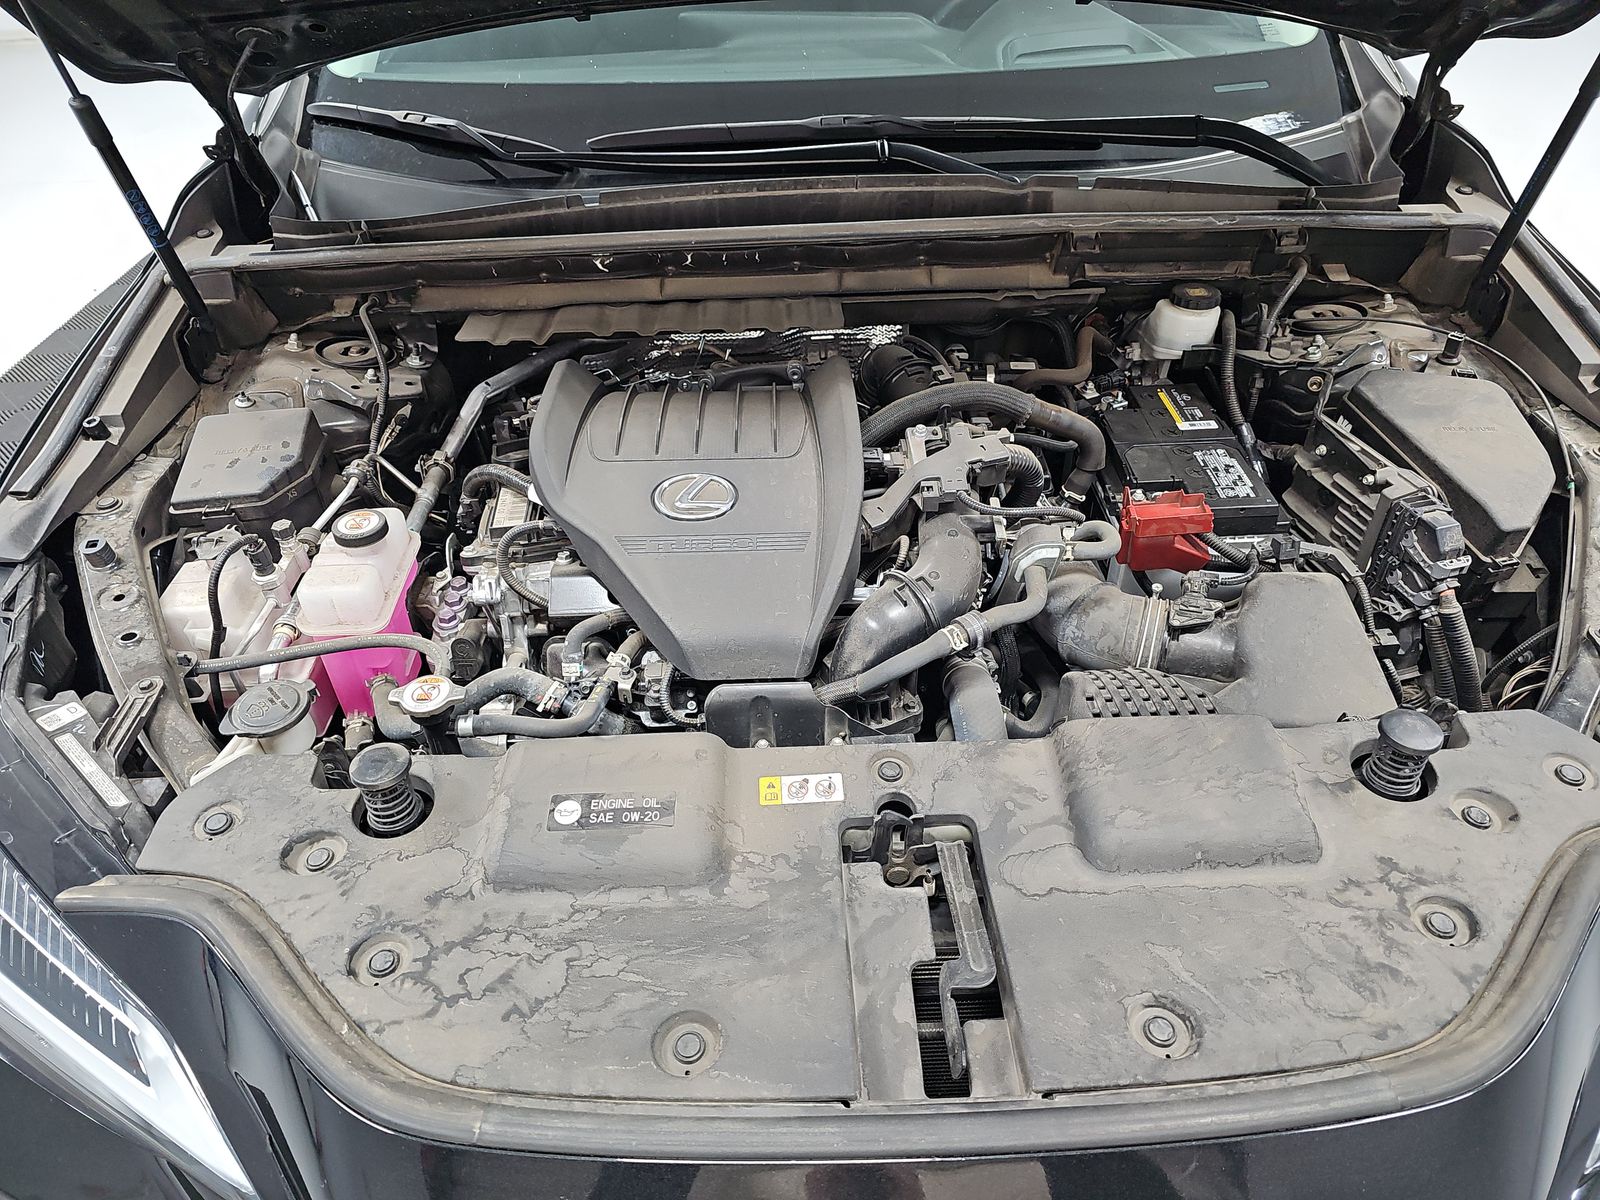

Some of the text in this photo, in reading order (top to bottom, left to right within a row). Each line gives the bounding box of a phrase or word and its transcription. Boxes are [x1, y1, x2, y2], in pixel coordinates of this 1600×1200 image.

[649, 537, 755, 551] TURBO
[590, 797, 661, 810] ENGINE OIL
[588, 810, 660, 824] SAE 0W-20
